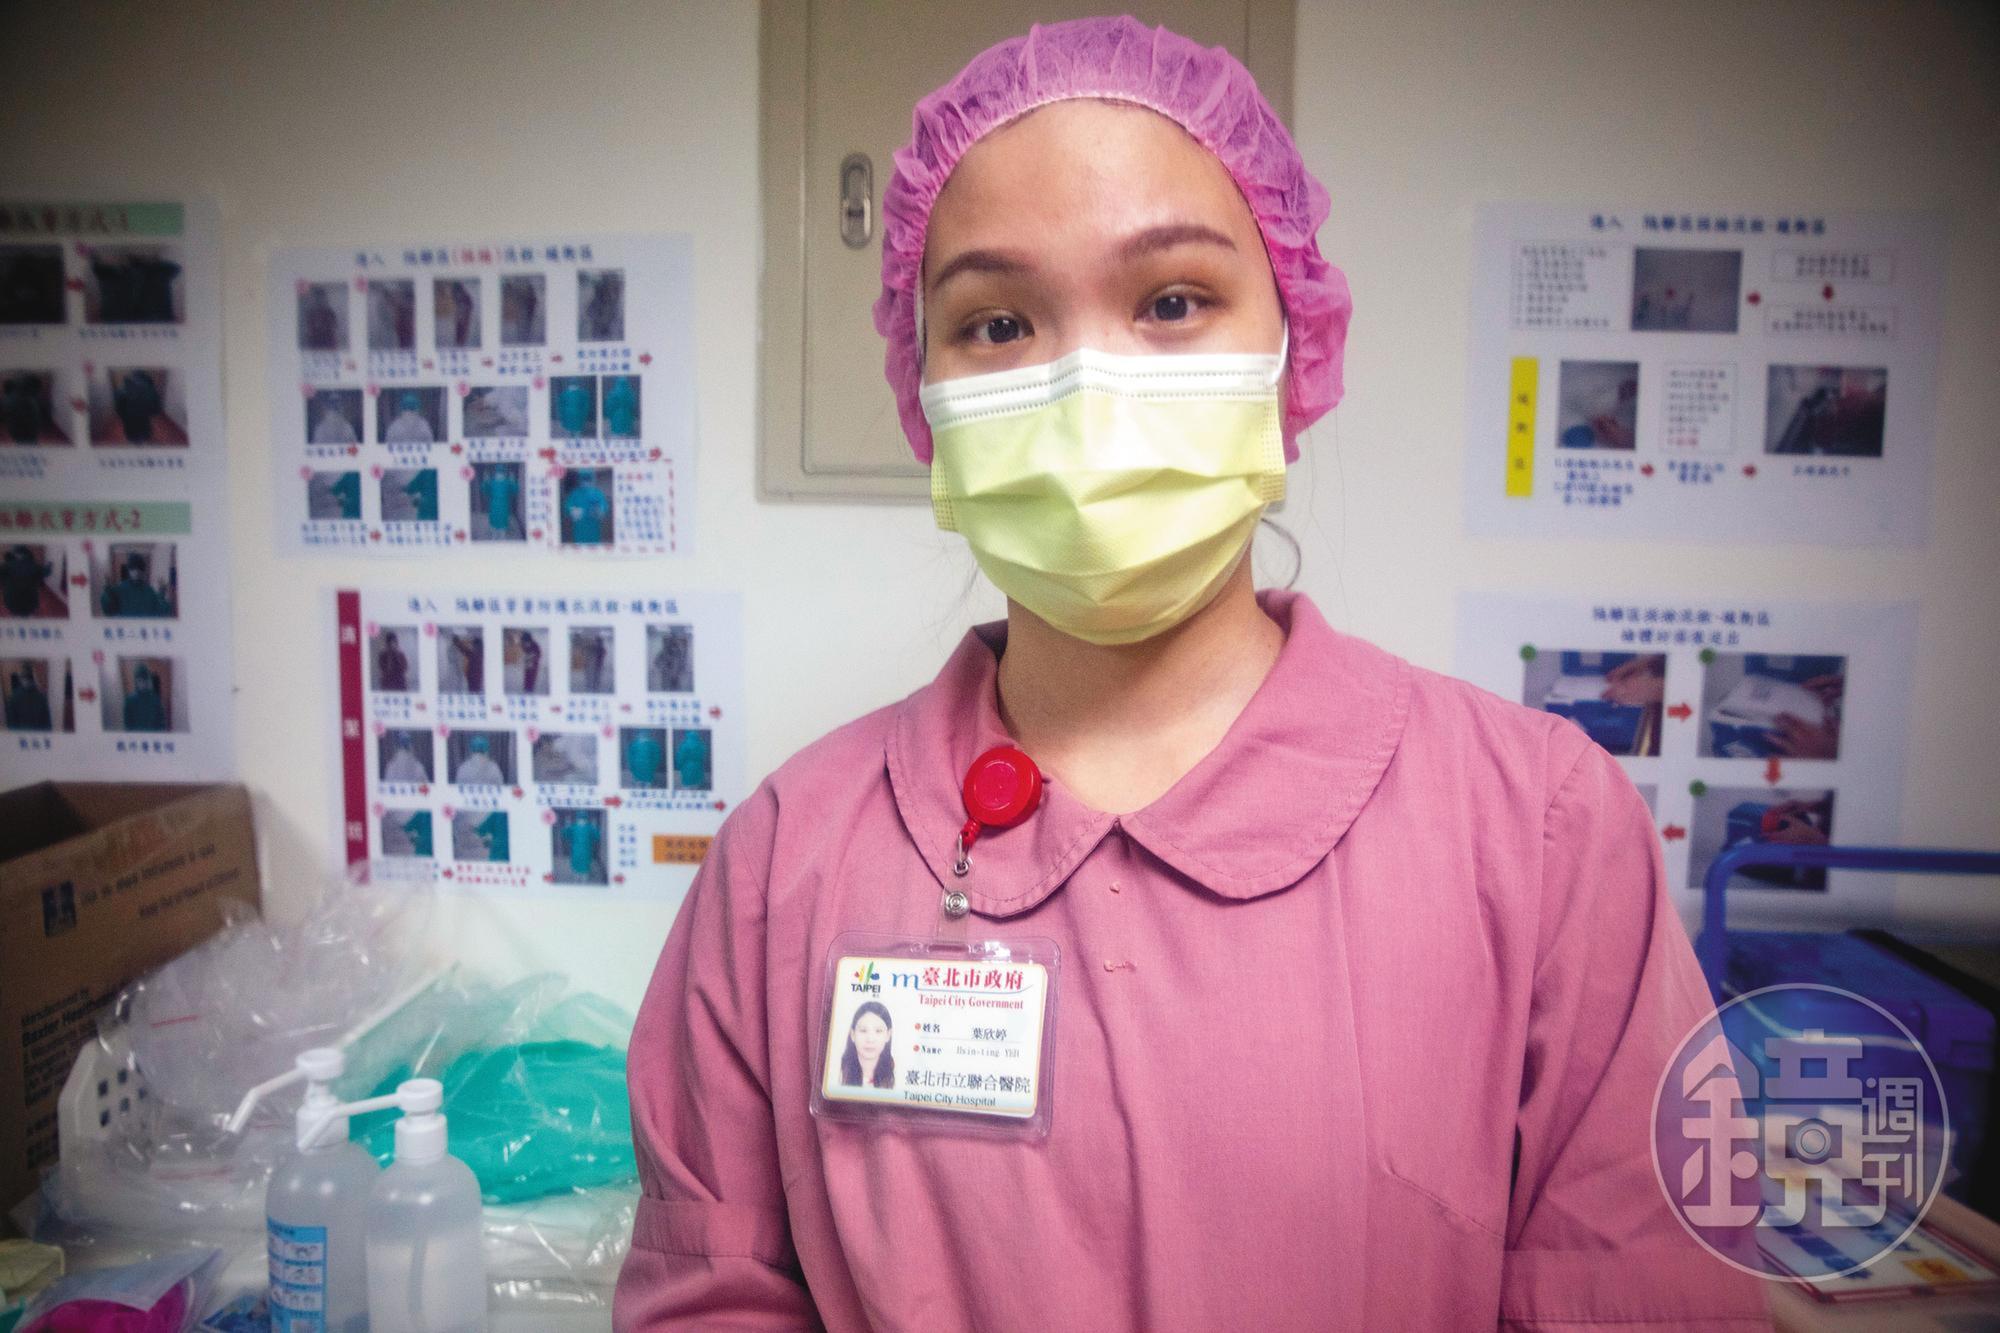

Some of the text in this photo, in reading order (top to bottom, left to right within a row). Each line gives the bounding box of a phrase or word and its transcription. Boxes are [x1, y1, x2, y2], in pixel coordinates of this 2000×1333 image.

[923, 966, 1023, 990] 臺北市政府
[851, 983, 881, 993] TAIPEI
[920, 994, 1024, 1010] Taipei City Government
[922, 1023, 941, 1033] 姓名
[921, 1045, 942, 1054] Name
[906, 1069, 1031, 1094] 臺北市立聯合醫院
[904, 1091, 996, 1106] Taipei City Hospital
